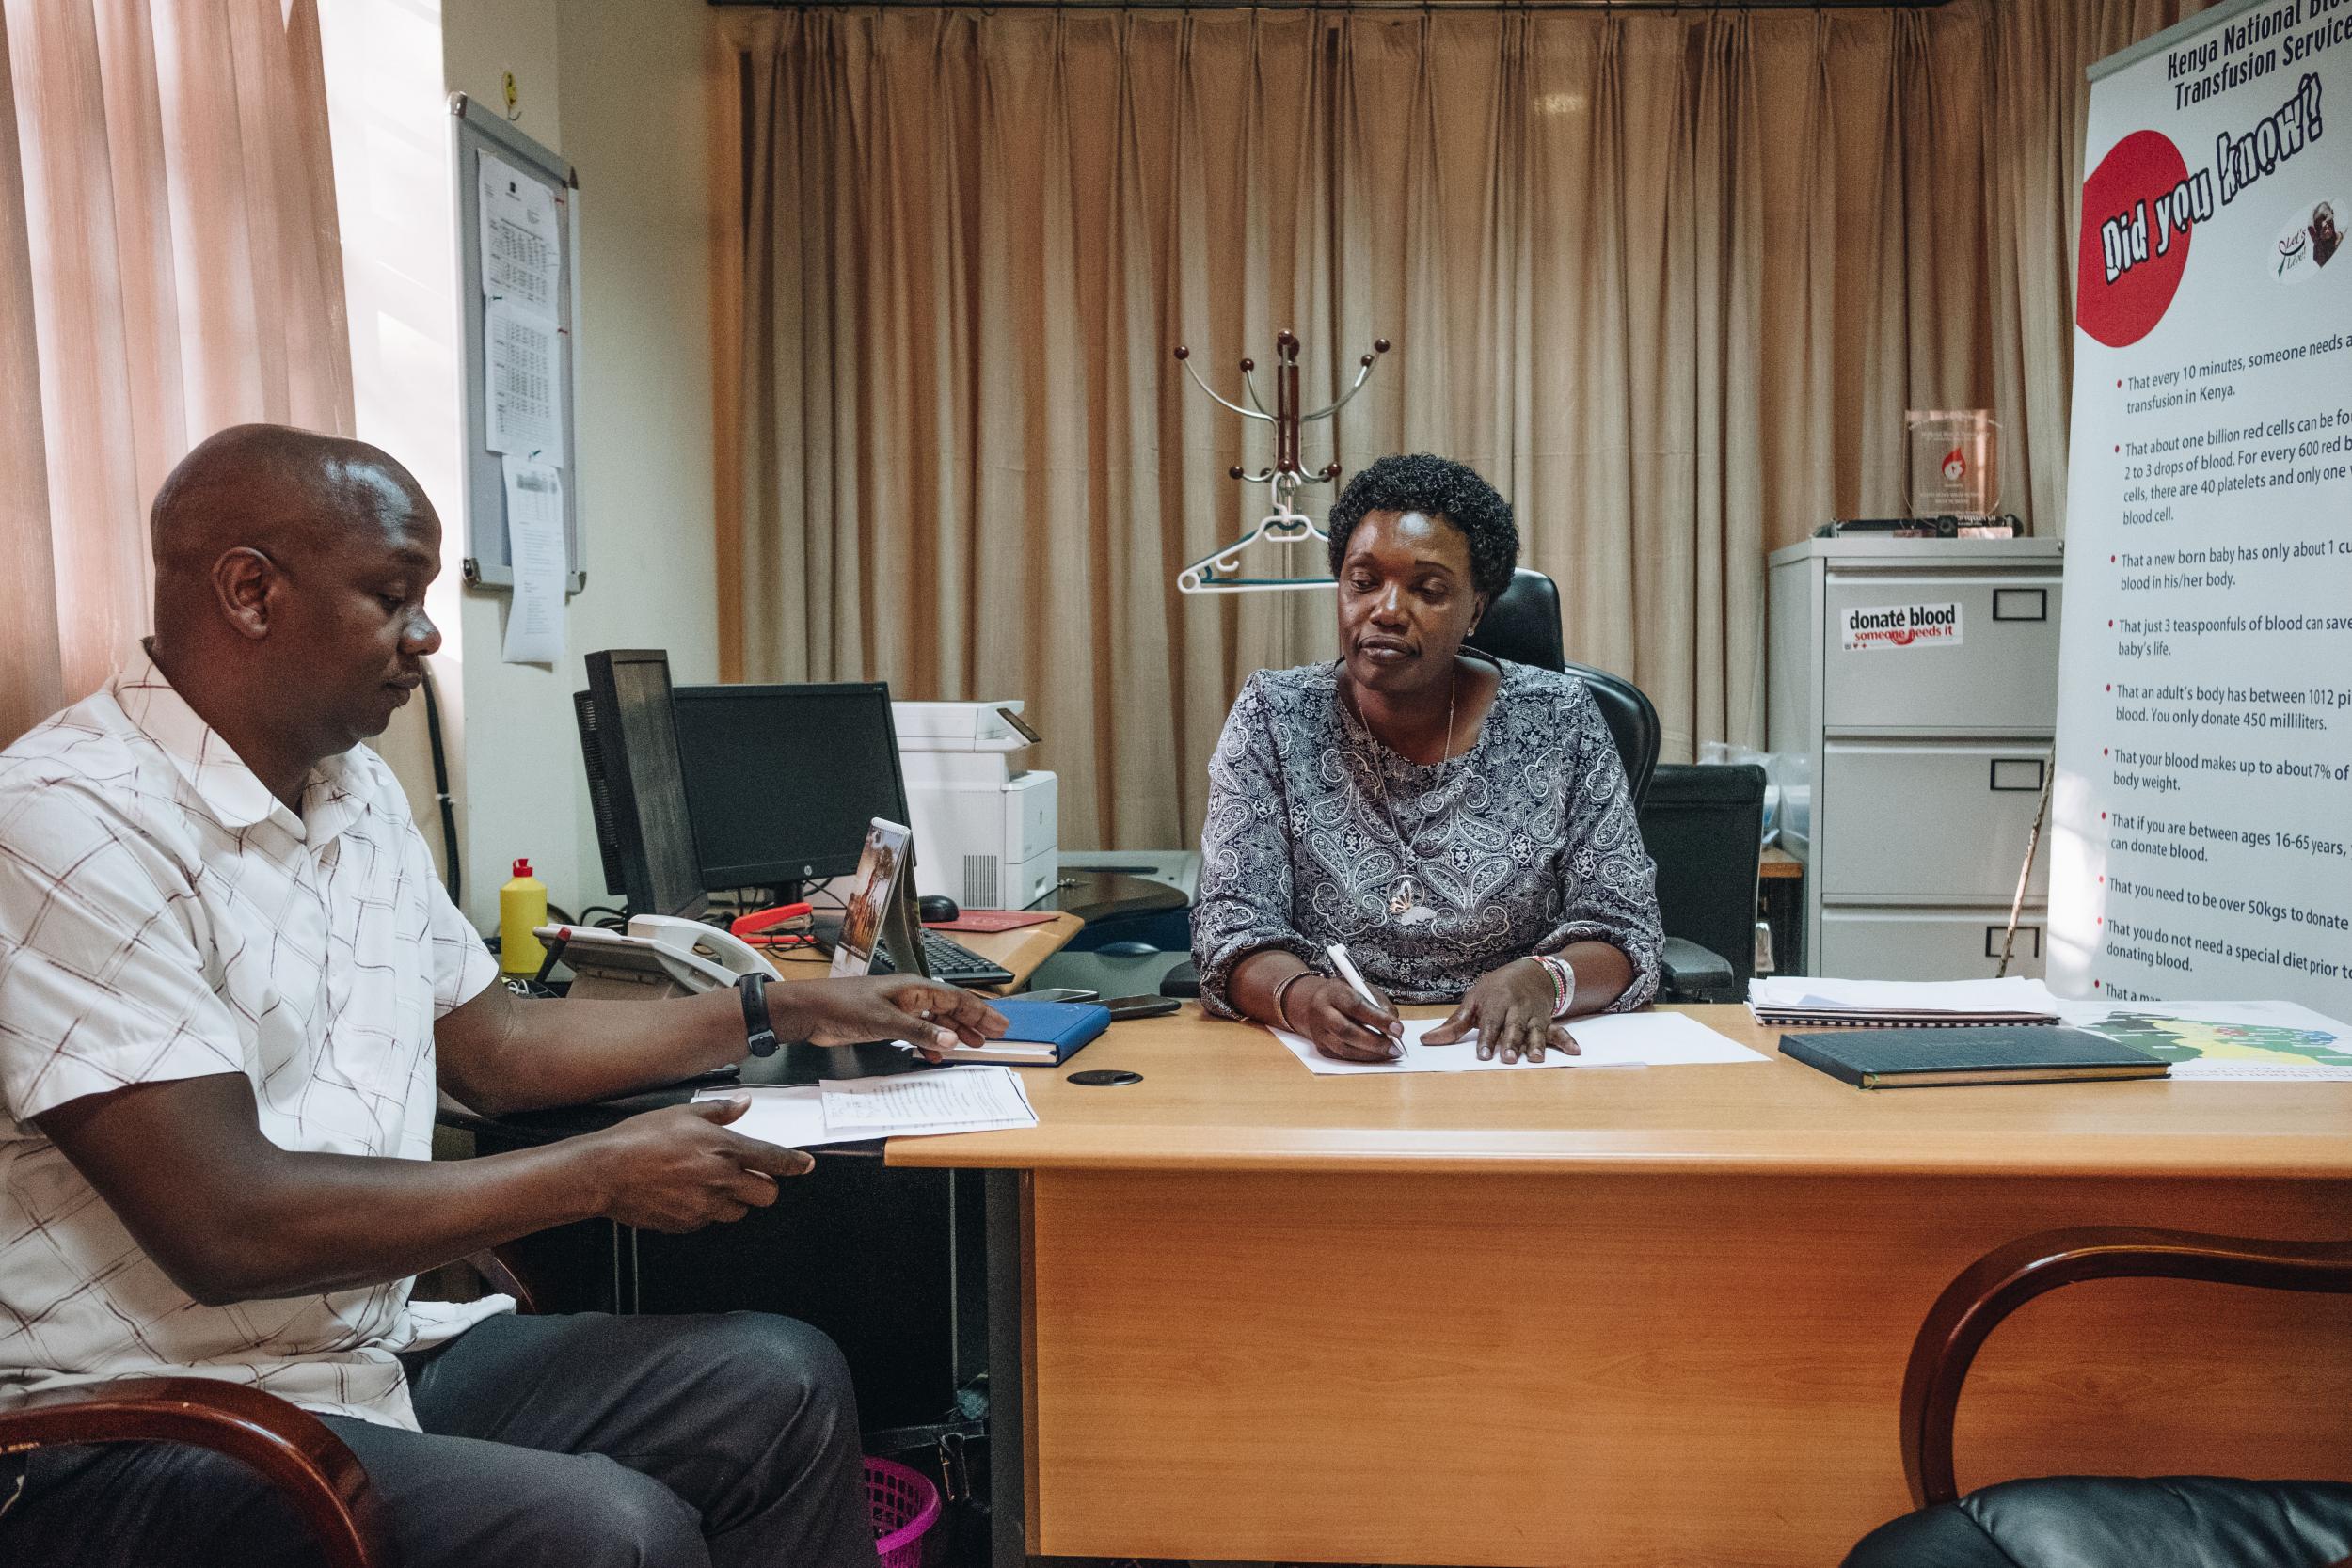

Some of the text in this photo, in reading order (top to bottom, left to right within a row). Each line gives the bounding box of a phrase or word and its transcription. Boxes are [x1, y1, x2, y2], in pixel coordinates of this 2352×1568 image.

[2168, 0, 2301, 82] Kenya National
[2175, 15, 2352, 110] Transfusion Service
[2102, 198, 2149, 285] Did
[2154, 167, 2214, 257] you
[2128, 376, 2150, 391] That
[2153, 371, 2180, 388] every
[2183, 365, 2196, 380] 10
[2199, 357, 2246, 377] minutes,
[2249, 345, 2307, 368] someone
[2309, 334, 2343, 356] needs
[2127, 384, 2235, 414] transfusion in Kenya.
[2125, 408, 2352, 457] That about one billion red cells can be fo
[2124, 467, 2131, 480] 2
[2133, 466, 2143, 480] to
[2146, 464, 2152, 477] 3
[2154, 457, 2184, 478] drops
[2185, 456, 2199, 472] of
[2201, 451, 2235, 469] blood.
[2238, 450, 2257, 466] For
[2260, 445, 2296, 464] every
[2298, 441, 2319, 457] 600
[2322, 436, 2341, 453] red
[2123, 485, 2148, 503] cells,
[2151, 482, 2177, 500] there
[2179, 483, 2198, 497] are
[2201, 479, 2216, 494] 40
[2217, 471, 2265, 496] platelets
[2269, 468, 2294, 486] and
[2296, 466, 2322, 485] only
[2323, 465, 2346, 480] one
[2123, 506, 2174, 525] blood cell.
[2122, 554, 2144, 568] That
[2146, 556, 2153, 566] a
[2154, 555, 2175, 566] new
[2178, 548, 2206, 564] born
[2210, 546, 2235, 566] baby
[2238, 545, 2258, 560] has
[2262, 543, 2290, 562] only
[2293, 540, 2326, 558] about
[2328, 539, 2334, 554] 1
[2121, 571, 2236, 591] blood in his/her body.
[1850, 604, 1955, 629] donate blood
[2120, 614, 2352, 636] That just 3 teaspoonfuls of blood can save
[1855, 625, 1953, 641] someone needs it
[2119, 641, 2171, 659] baby's life.
[2117, 684, 2139, 699] That
[2142, 689, 2154, 699] an
[2156, 686, 2193, 701] adult's
[2197, 686, 2225, 705] body
[2227, 688, 2247, 703] has
[2249, 688, 2306, 704] between
[2309, 689, 2334, 705] 1012
[2116, 707, 2327, 731] blood. You only donate 450 milliliters.
[2115, 749, 2350, 781] That your blood makes up to about 7% of
[2113, 772, 2181, 793] body weight.
[2110, 838, 2208, 863] can donate blood.
[2112, 813, 2135, 829] That
[2137, 816, 2145, 831] if
[2147, 819, 2165, 834] you
[2167, 823, 2186, 835] are
[2188, 821, 2238, 842] between
[2241, 830, 2271, 848] ages
[2275, 832, 2310, 850] 16-65
[2312, 837, 2347, 858] years,
[2109, 878, 2349, 931] That you need to be over 50kgs to donate
[2106, 942, 2193, 972] donating blood.
[2107, 919, 2131, 936] That
[2133, 925, 2153, 941] you
[2154, 927, 2169, 943] do
[2171, 933, 2192, 949] not
[2195, 937, 2223, 955] need
[2226, 944, 2233, 957] a
[2235, 946, 2280, 966] special
[2283, 951, 2307, 971] diet
[2310, 958, 2339, 977] prior
[2106, 982, 2128, 1001] That
[2131, 992, 2137, 1001] a
